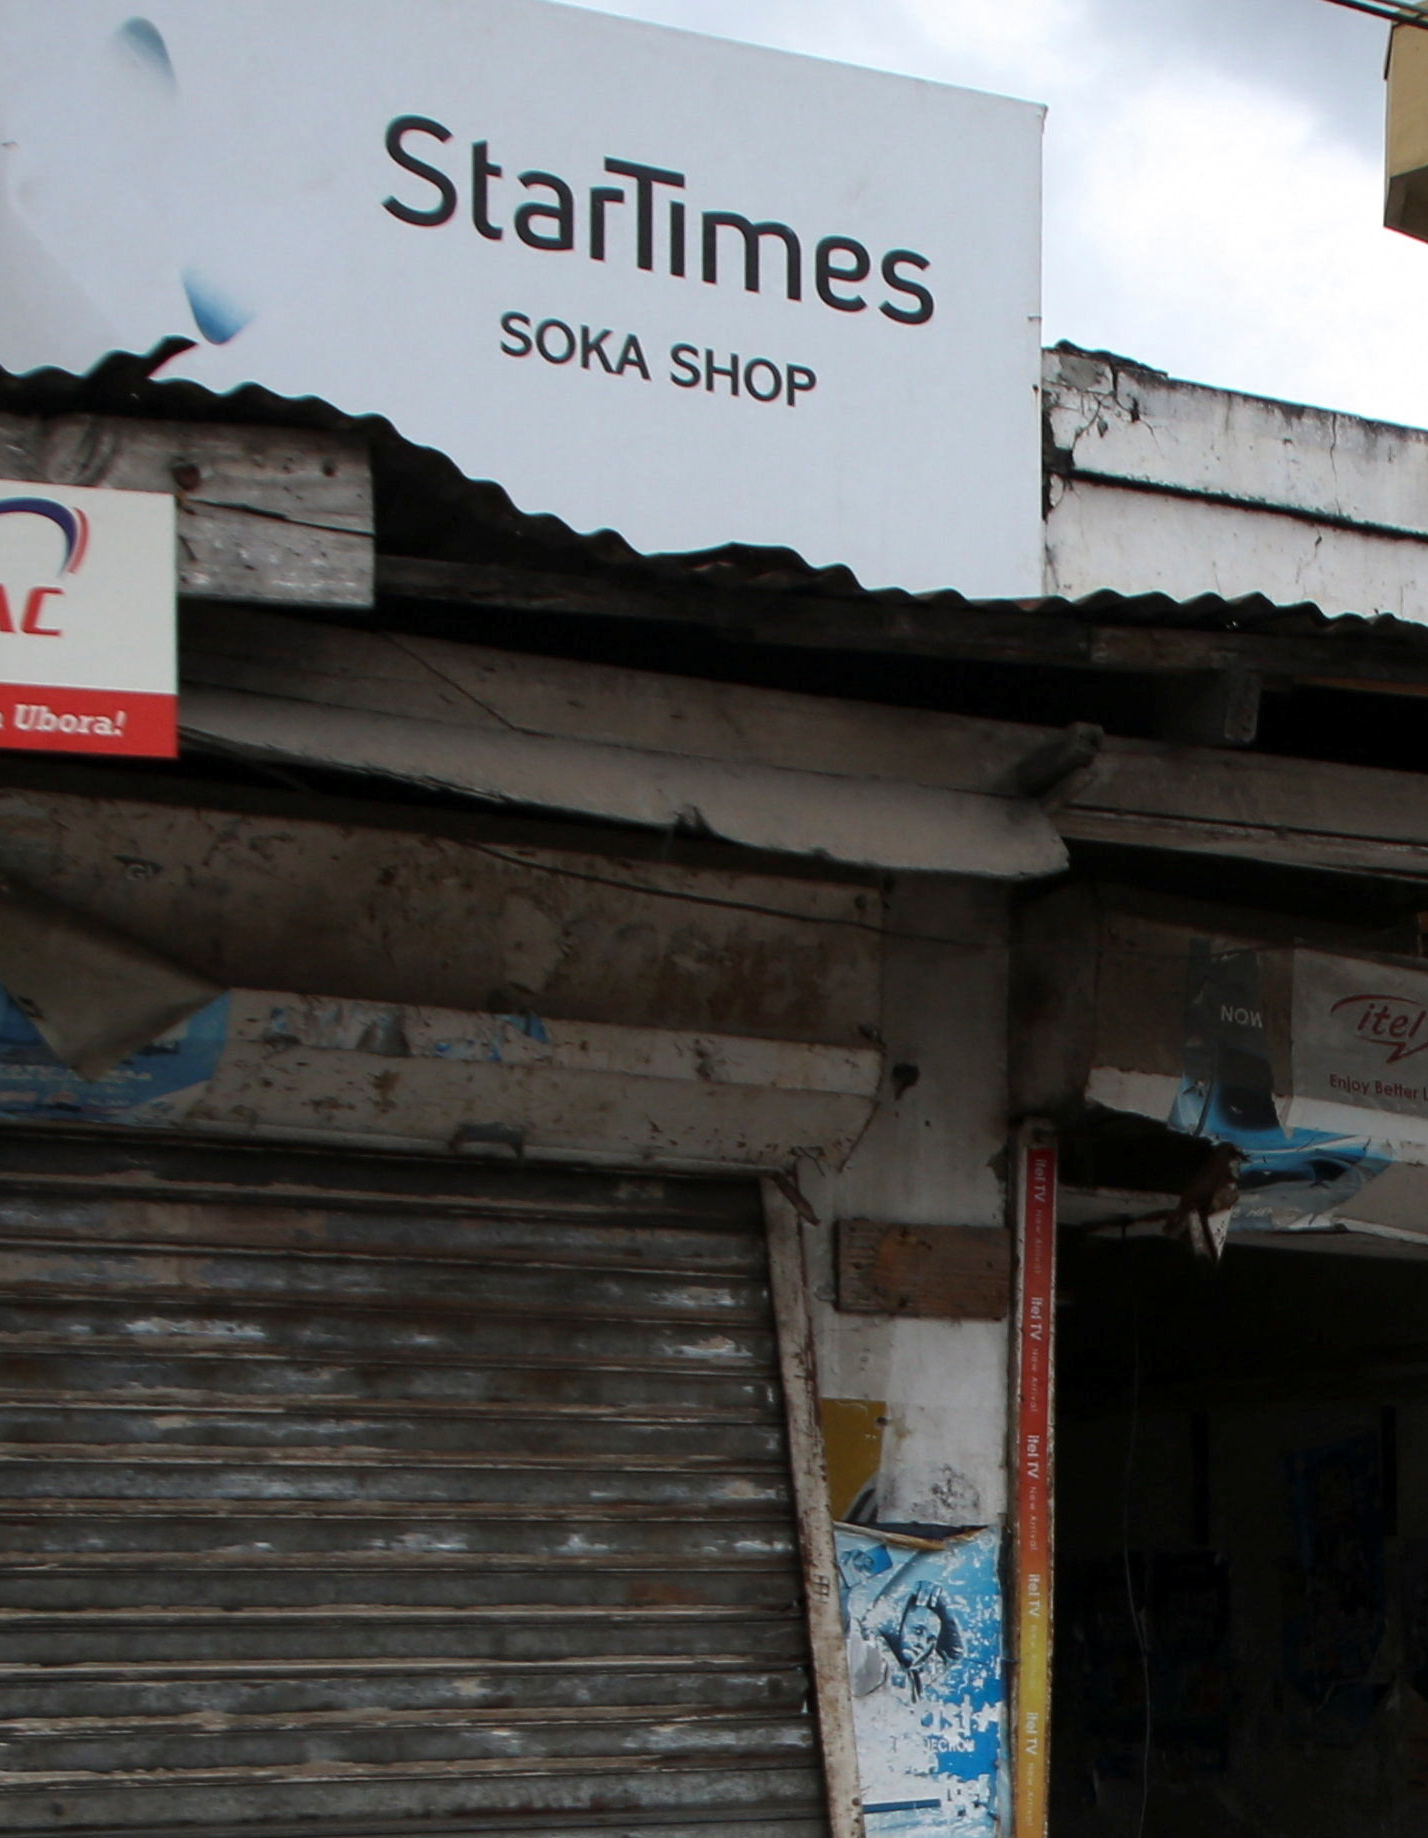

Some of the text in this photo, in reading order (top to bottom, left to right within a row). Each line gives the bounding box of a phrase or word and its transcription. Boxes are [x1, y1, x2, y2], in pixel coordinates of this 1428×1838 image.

[381, 113, 935, 326] StarTimes
[499, 311, 817, 407] SOKA SHOP
[13, 704, 127, 736] Ubora!
[1356, 1003, 1428, 1040] itel
[1328, 1073, 1371, 1097] Enjoy
[1373, 1079, 1419, 1100] Better
[1031, 1297, 1044, 1322] itel
[1030, 1323, 1043, 1341] TV
[1027, 1435, 1040, 1459] itel
[1026, 1460, 1039, 1479] TV
[1027, 1574, 1041, 1617] itel TV
[1025, 1712, 1038, 1736] itel
[1024, 1737, 1038, 1755] TV
